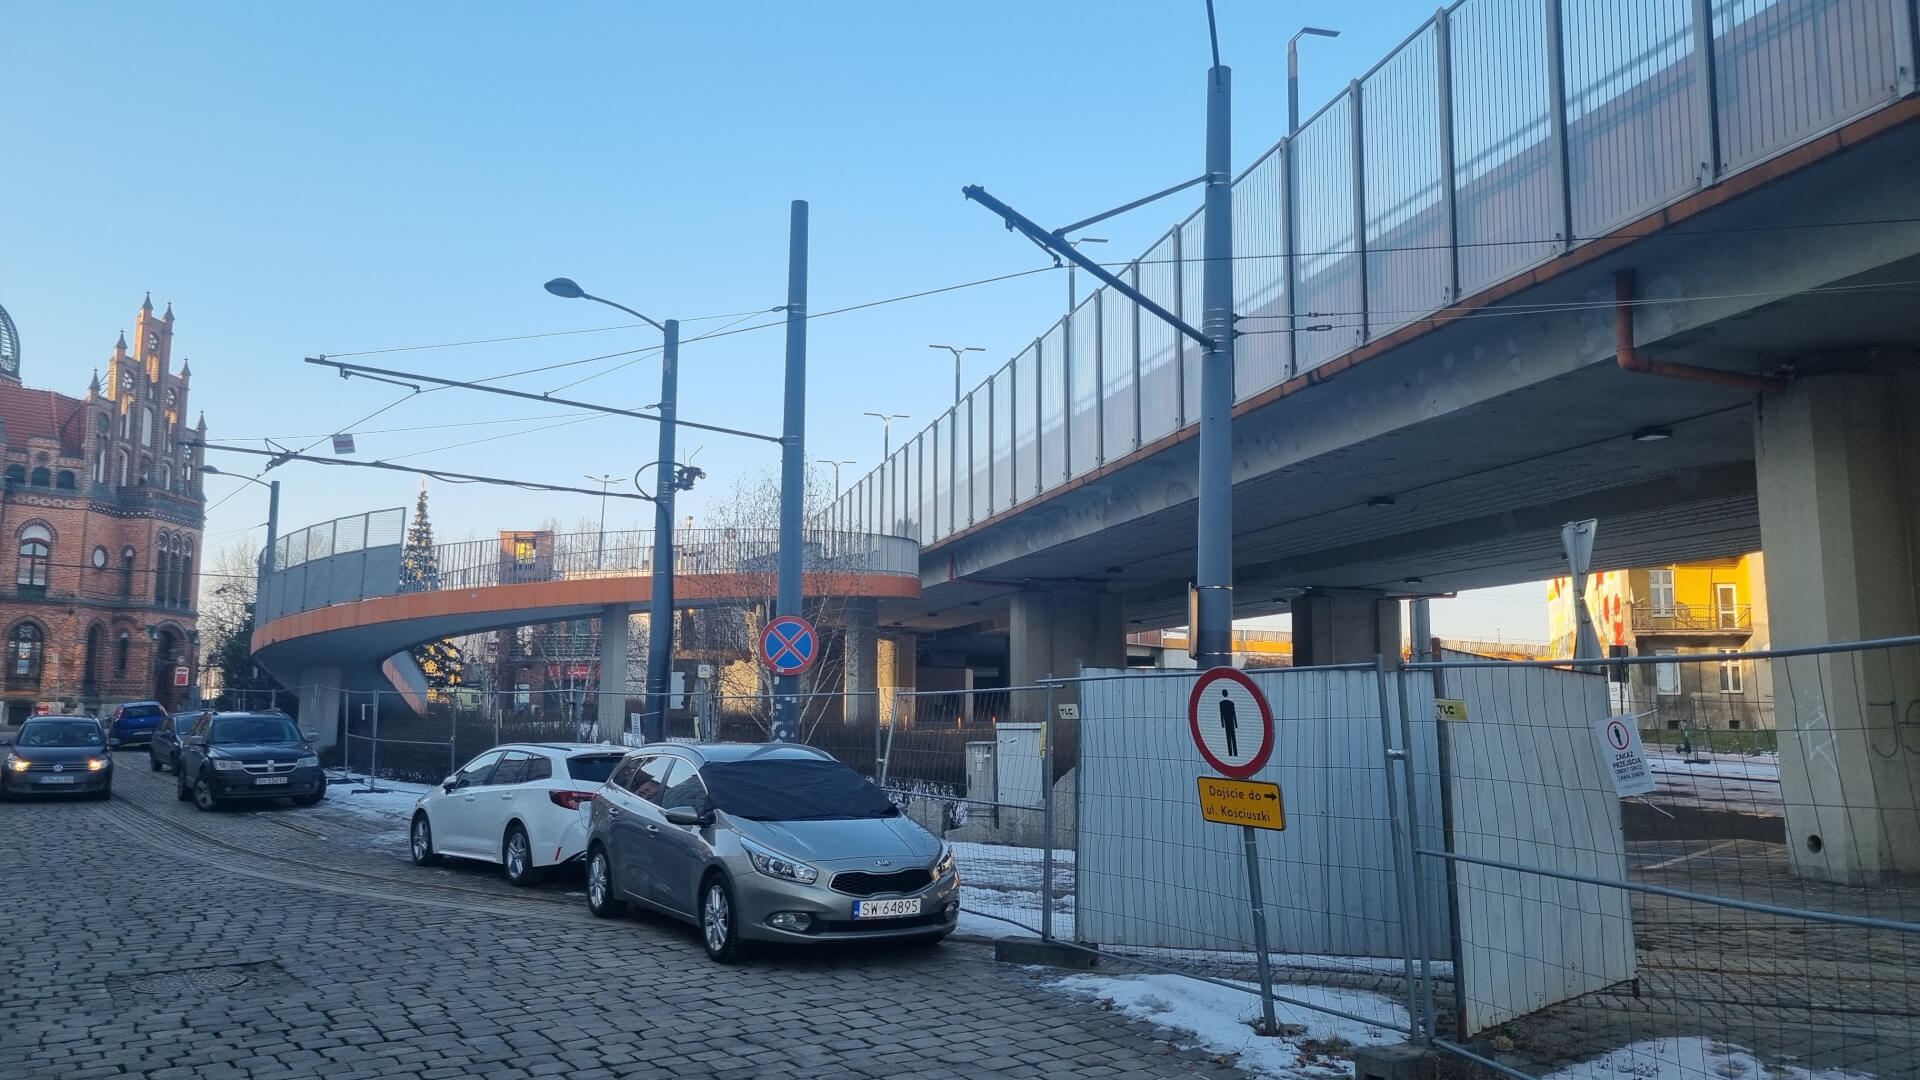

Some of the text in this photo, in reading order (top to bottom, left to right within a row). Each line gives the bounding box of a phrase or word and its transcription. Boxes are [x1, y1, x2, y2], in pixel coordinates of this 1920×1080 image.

[1060, 708, 1073, 716] TLC
[1615, 751, 1634, 761] ZAKAZ
[1208, 785, 1262, 801] Dojście do
[1206, 805, 1271, 822] ul. Kościuszki
[862, 900, 918, 916] SW 64895
